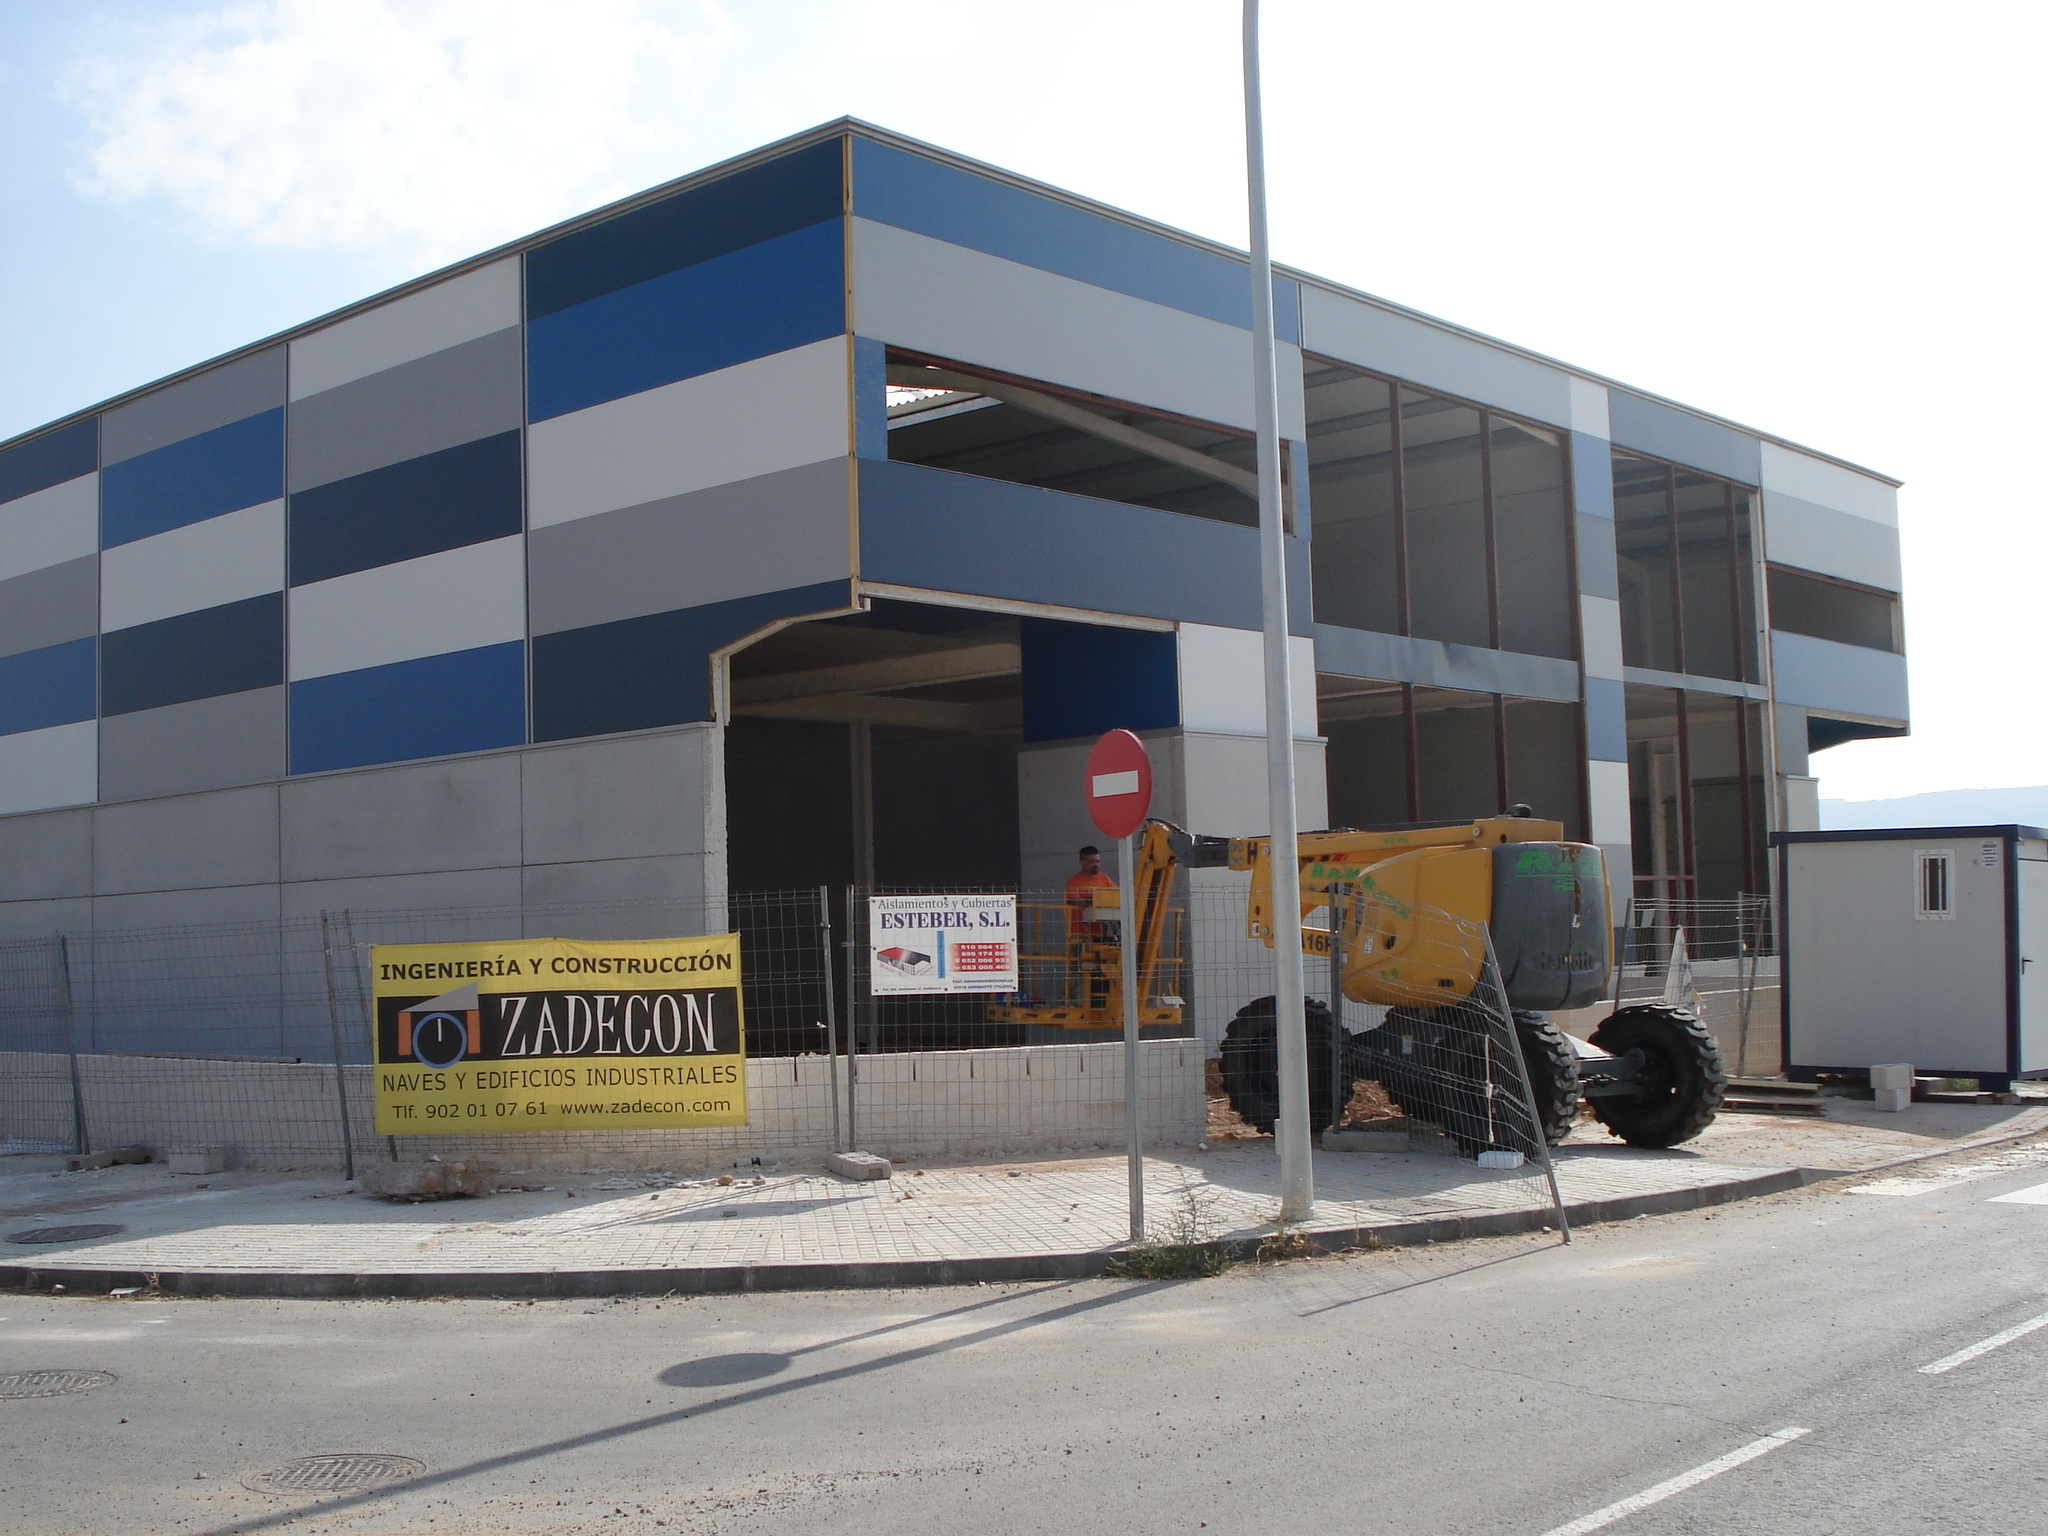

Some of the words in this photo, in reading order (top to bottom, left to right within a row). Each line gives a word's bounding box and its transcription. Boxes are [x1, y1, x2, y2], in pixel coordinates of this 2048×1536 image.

[878, 899, 949, 910] Aislamientos
[952, 901, 959, 911] y
[961, 898, 1012, 909] Cubiertas
[881, 911, 974, 931] ESTEBER,
[979, 911, 1010, 927] S.L.
[381, 955, 522, 981] INGENIERÍA
[529, 958, 543, 975] Y
[551, 949, 733, 974] CONSTRUCCIÓN
[500, 993, 718, 1056] ZADECON
[383, 1073, 447, 1092] NAVES
[455, 1072, 467, 1090] Y
[477, 1069, 576, 1089] EDIFICIOS
[586, 1065, 738, 1087] INDUSTRIALES
[392, 1104, 419, 1119] Tlf.
[426, 1104, 460, 1119] 902
[467, 1103, 488, 1118] 01
[495, 1102, 517, 1117] 07
[526, 1101, 548, 1116] 61
[560, 1097, 731, 1115] www.zadecon.com
